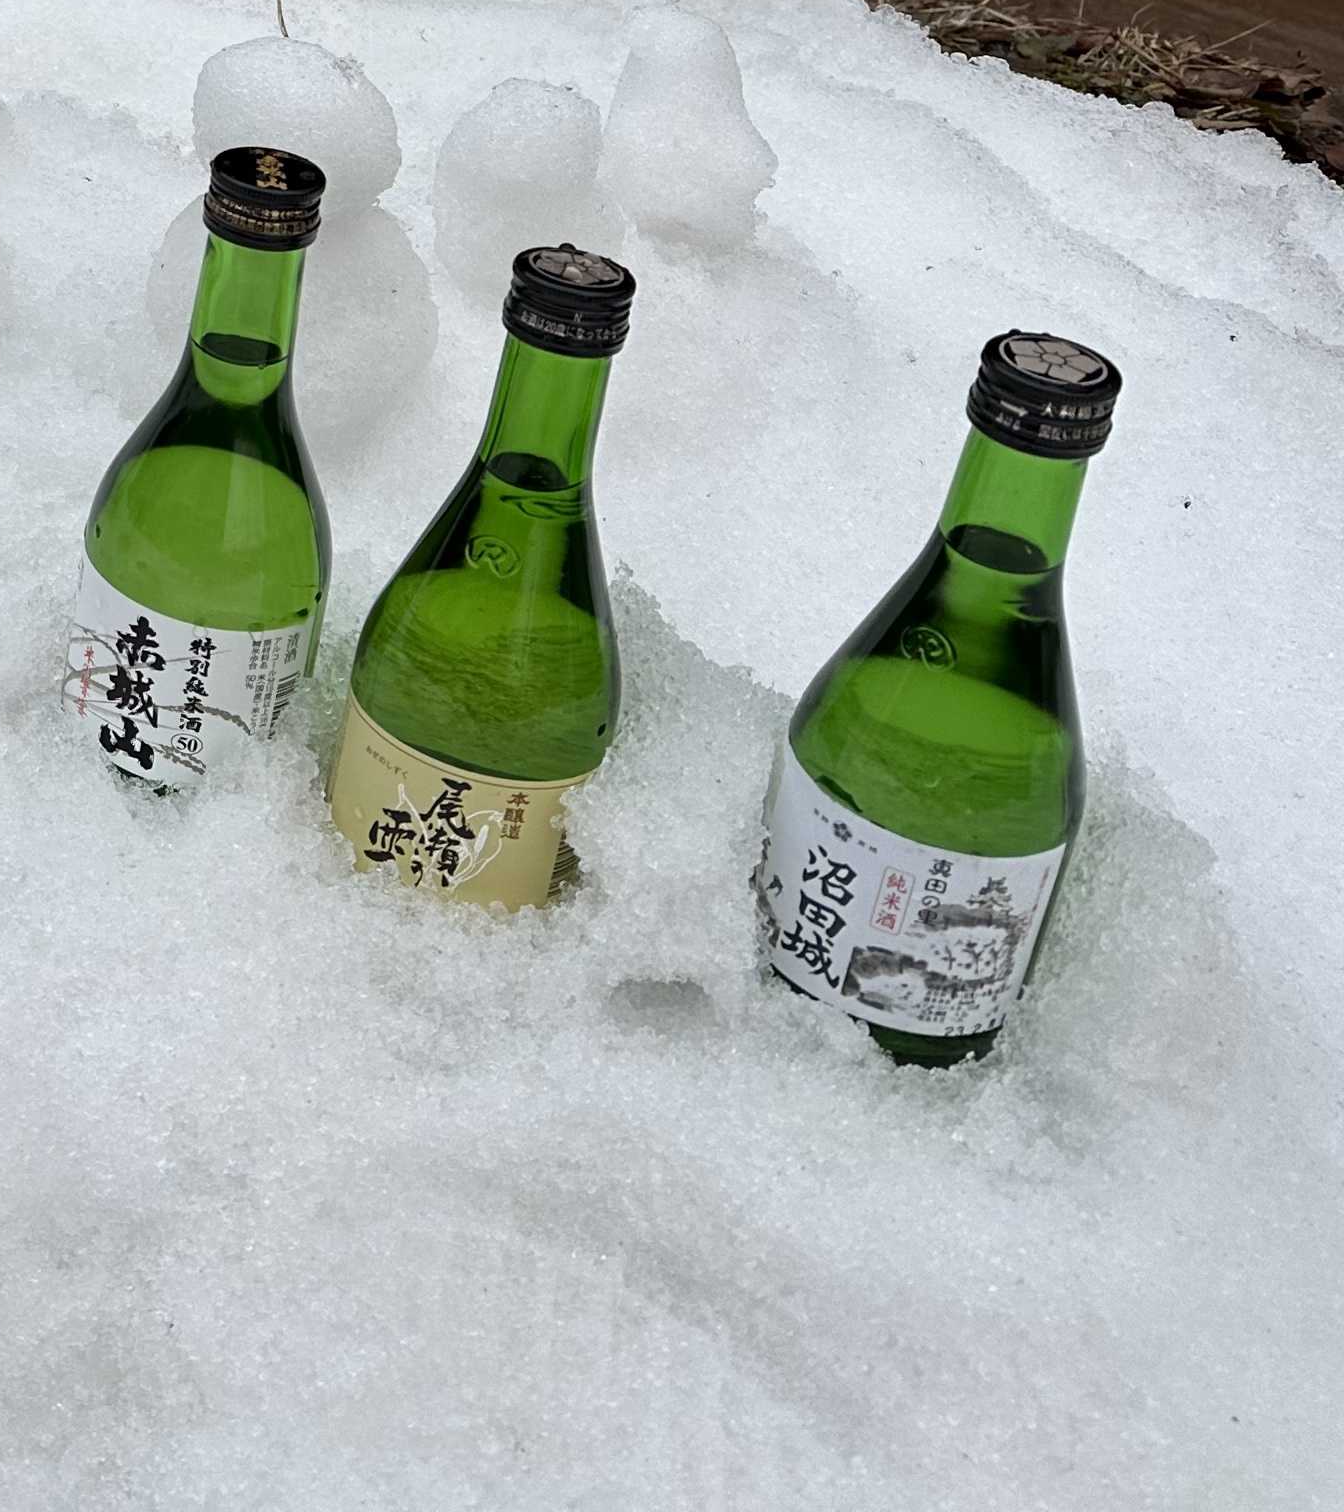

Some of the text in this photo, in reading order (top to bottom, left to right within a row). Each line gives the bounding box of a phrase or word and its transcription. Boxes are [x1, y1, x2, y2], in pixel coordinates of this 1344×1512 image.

[98, 615, 166, 771] 赤城山
[178, 636, 218, 733] 特別純米酒
[176, 736, 199, 753] 50
[780, 844, 860, 990] 沼田城
[874, 872, 909, 930] 純米酒
